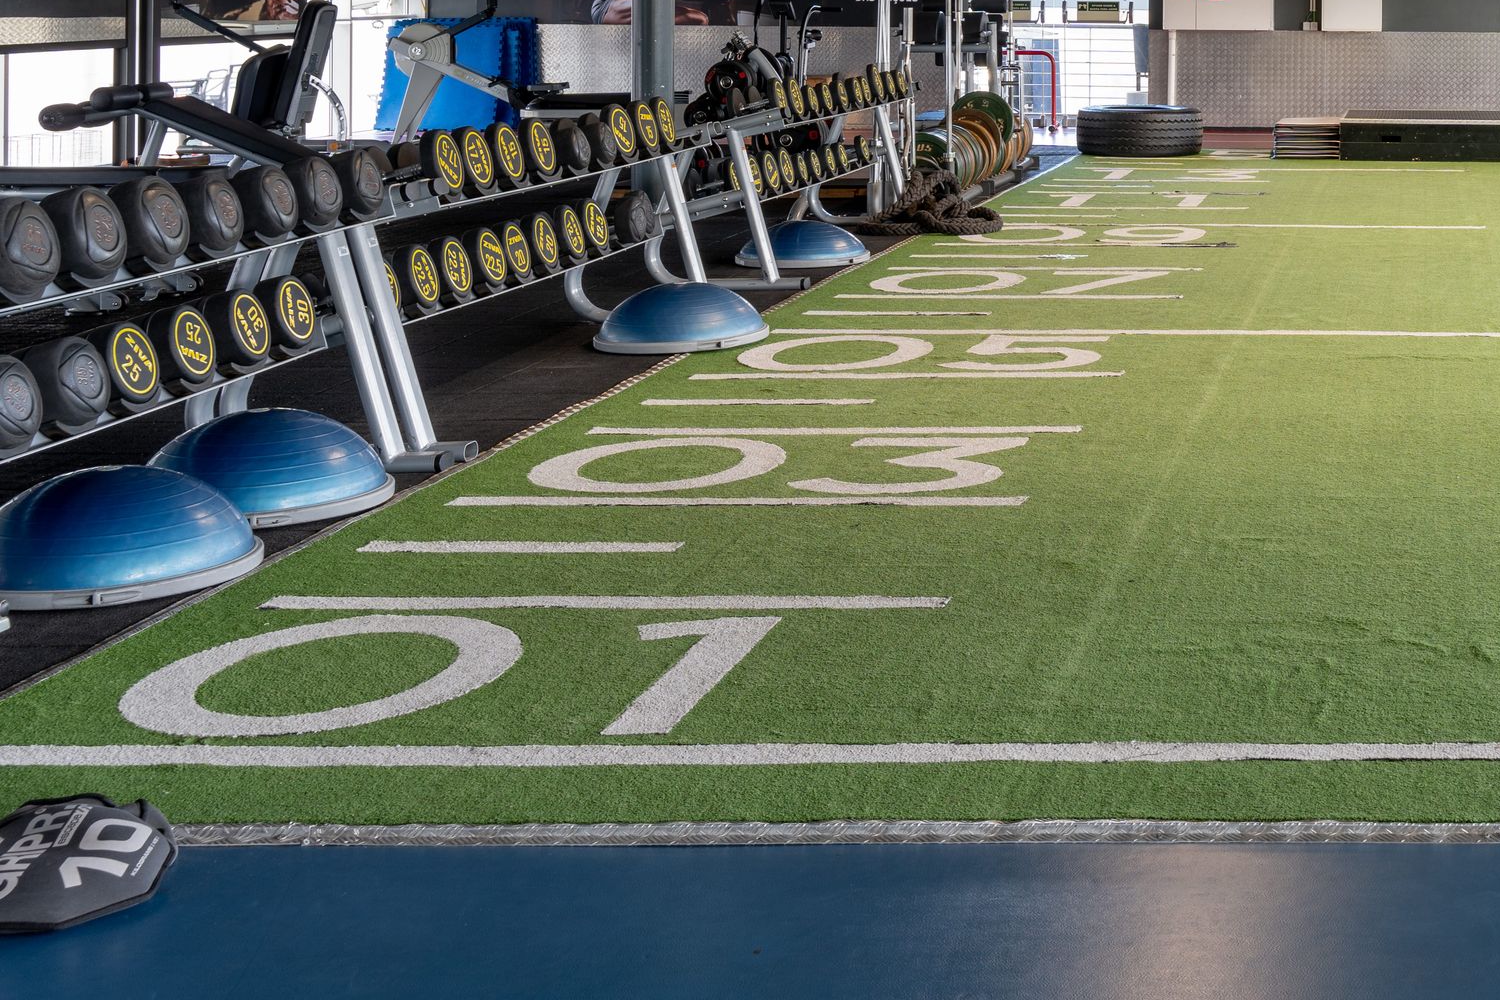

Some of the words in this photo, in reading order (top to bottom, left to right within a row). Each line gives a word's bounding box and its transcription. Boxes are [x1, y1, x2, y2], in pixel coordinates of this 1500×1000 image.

[247, 305, 264, 332] 30
[286, 286, 297, 328] ZIVA
[296, 299, 310, 325] 30
[185, 321, 202, 344] 25
[236, 307, 258, 348] ZIVA
[121, 353, 142, 382] 25
[123, 334, 152, 373] ZIVA
[180, 344, 208, 364] ZIVA
[59, 818, 152, 889] 10
